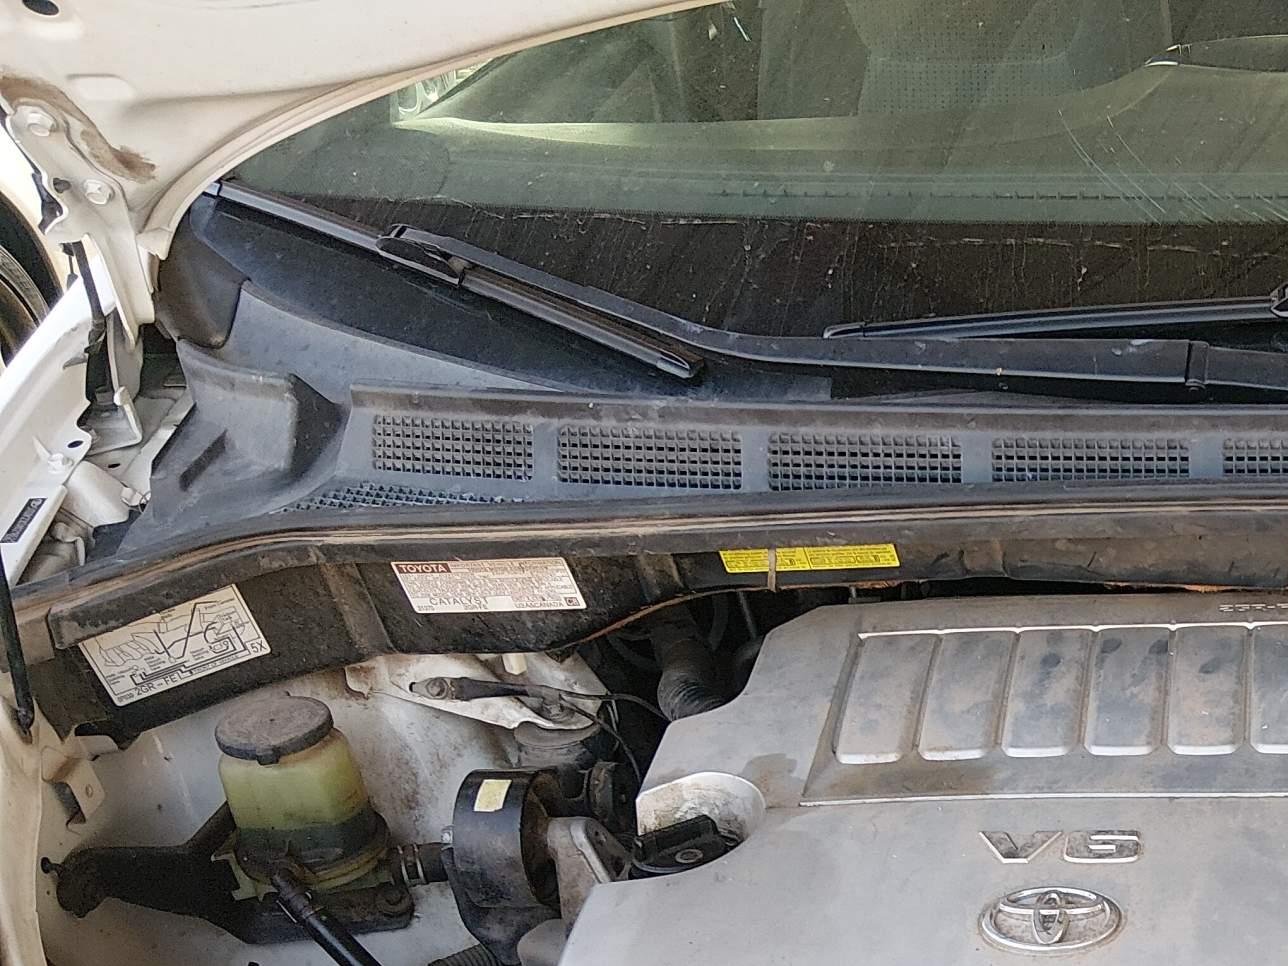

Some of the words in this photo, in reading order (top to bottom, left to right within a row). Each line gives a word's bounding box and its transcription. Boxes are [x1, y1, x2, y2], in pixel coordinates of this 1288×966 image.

[400, 564, 446, 573] TOYOTA
[429, 596, 489, 606] CATALYST
[250, 640, 267, 654] 5X
[979, 831, 1140, 863] V6
